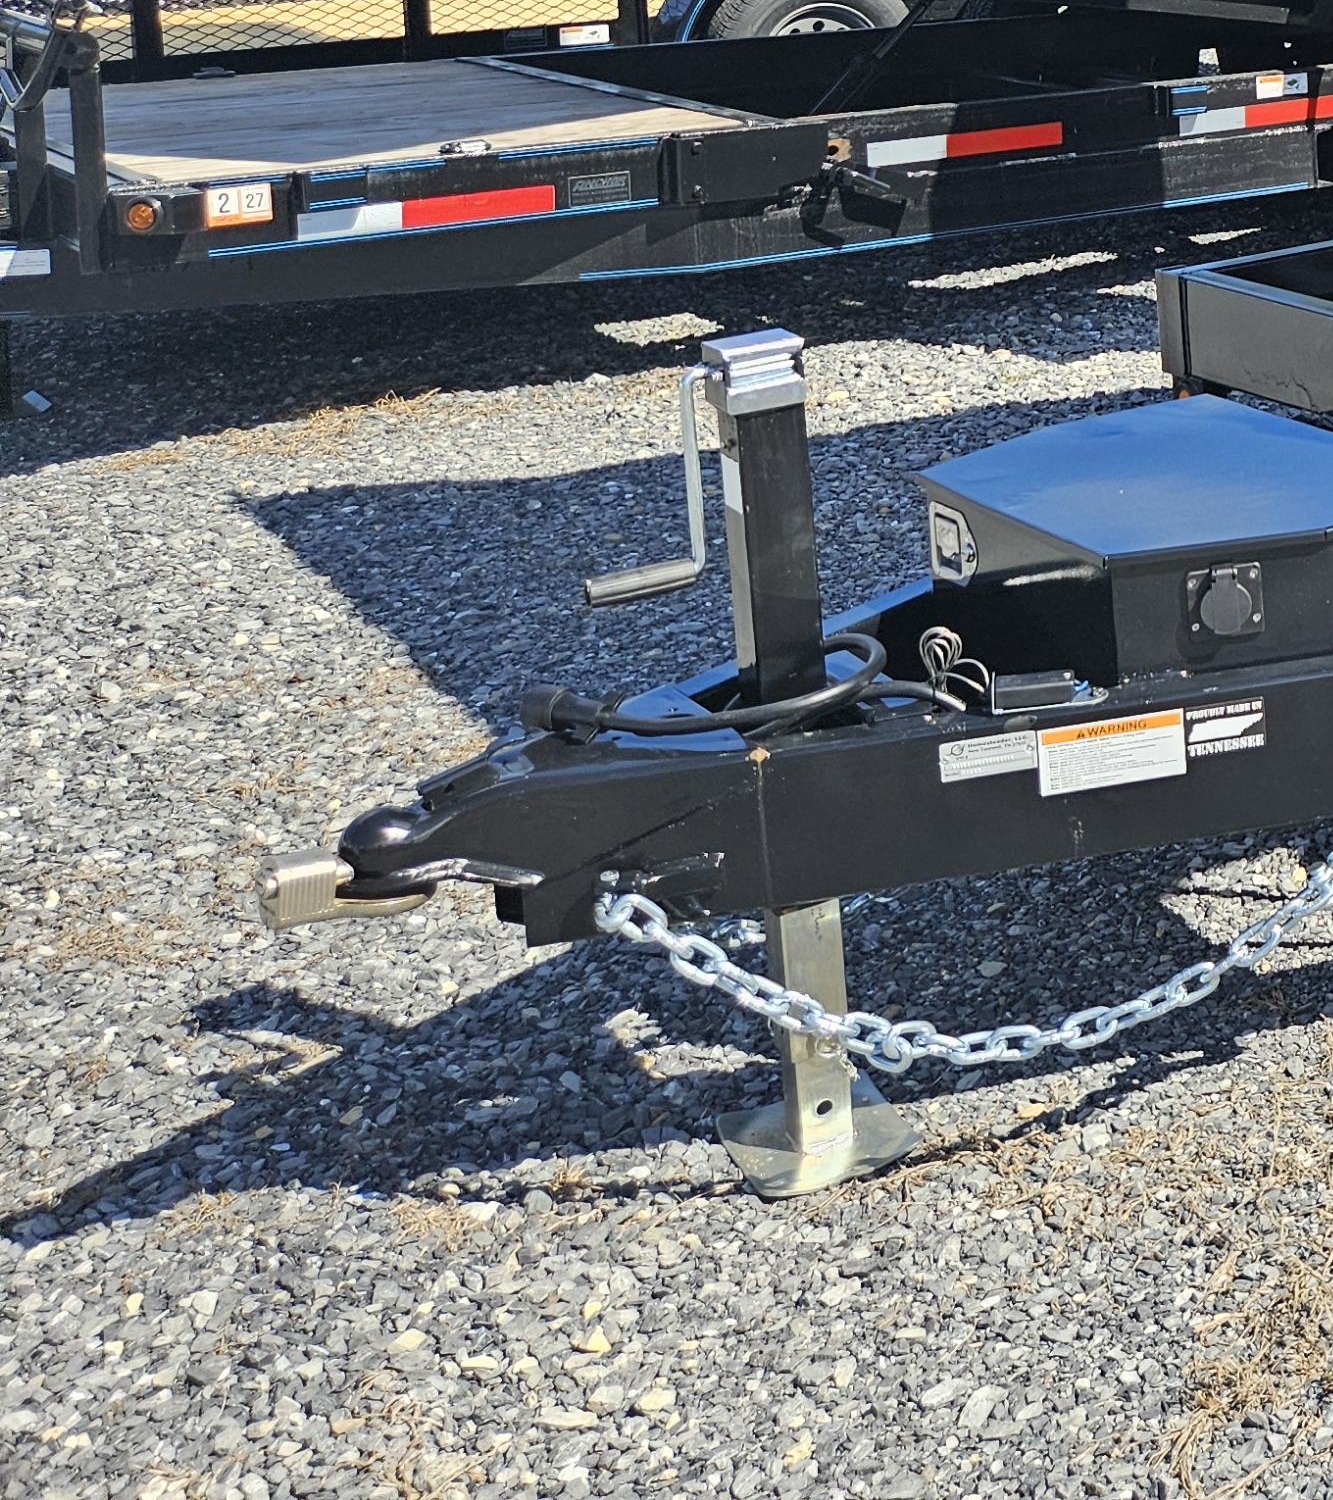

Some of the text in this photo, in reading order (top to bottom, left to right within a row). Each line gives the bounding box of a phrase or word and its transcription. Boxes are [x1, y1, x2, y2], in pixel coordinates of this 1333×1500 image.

[218, 192, 264, 213] 2 27
[1087, 719, 1147, 737] WARNING
[1187, 733, 1265, 757] TENNESSEE
